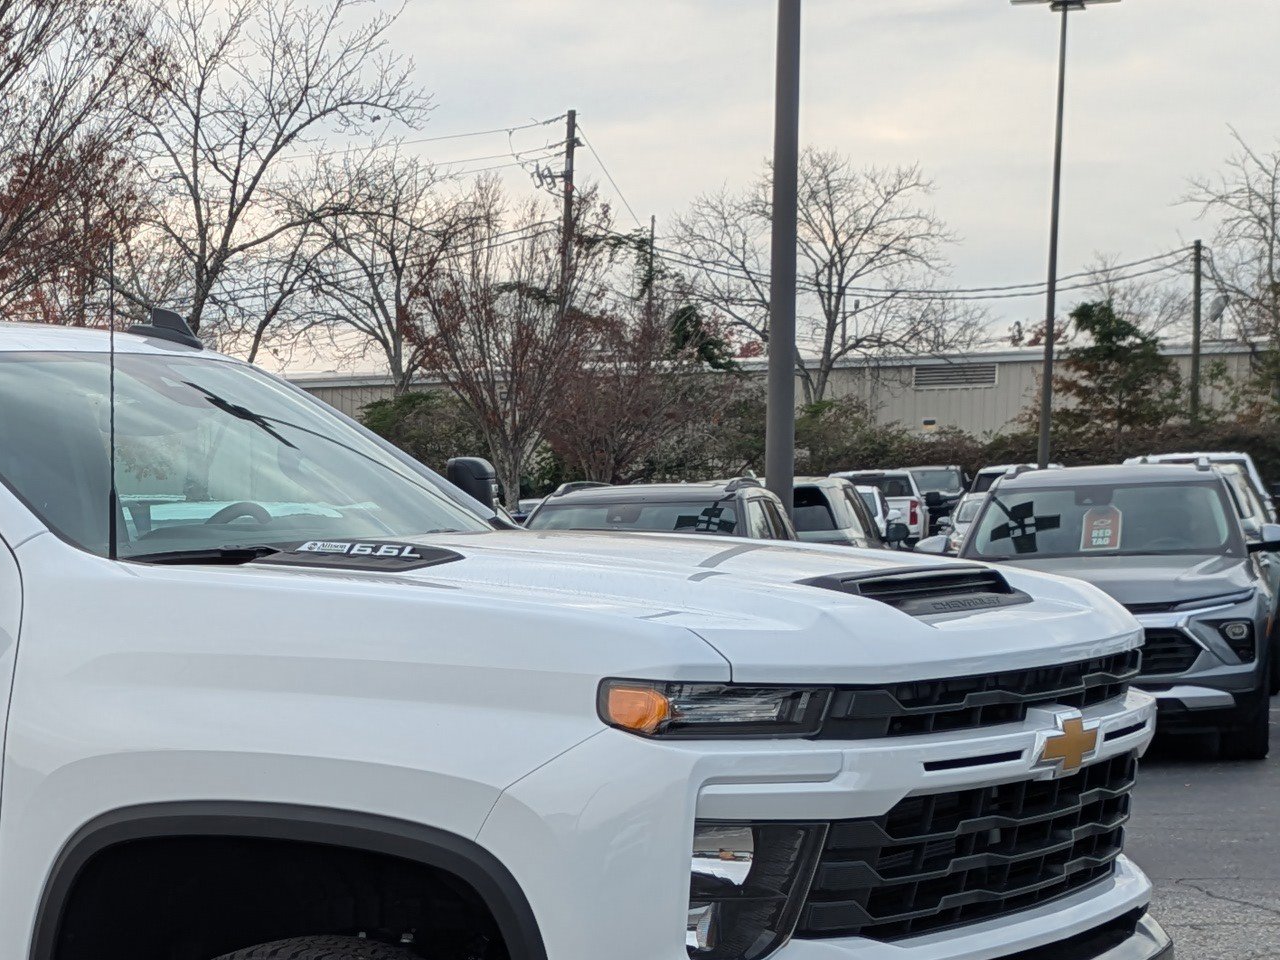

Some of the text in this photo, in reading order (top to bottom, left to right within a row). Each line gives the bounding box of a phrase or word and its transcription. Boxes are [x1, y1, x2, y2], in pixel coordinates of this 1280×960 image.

[1091, 529, 1112, 538] RED
[1091, 538, 1111, 546] TAG
[350, 543, 422, 558] 6.6L
[931, 596, 1000, 610] CHEVROLET
